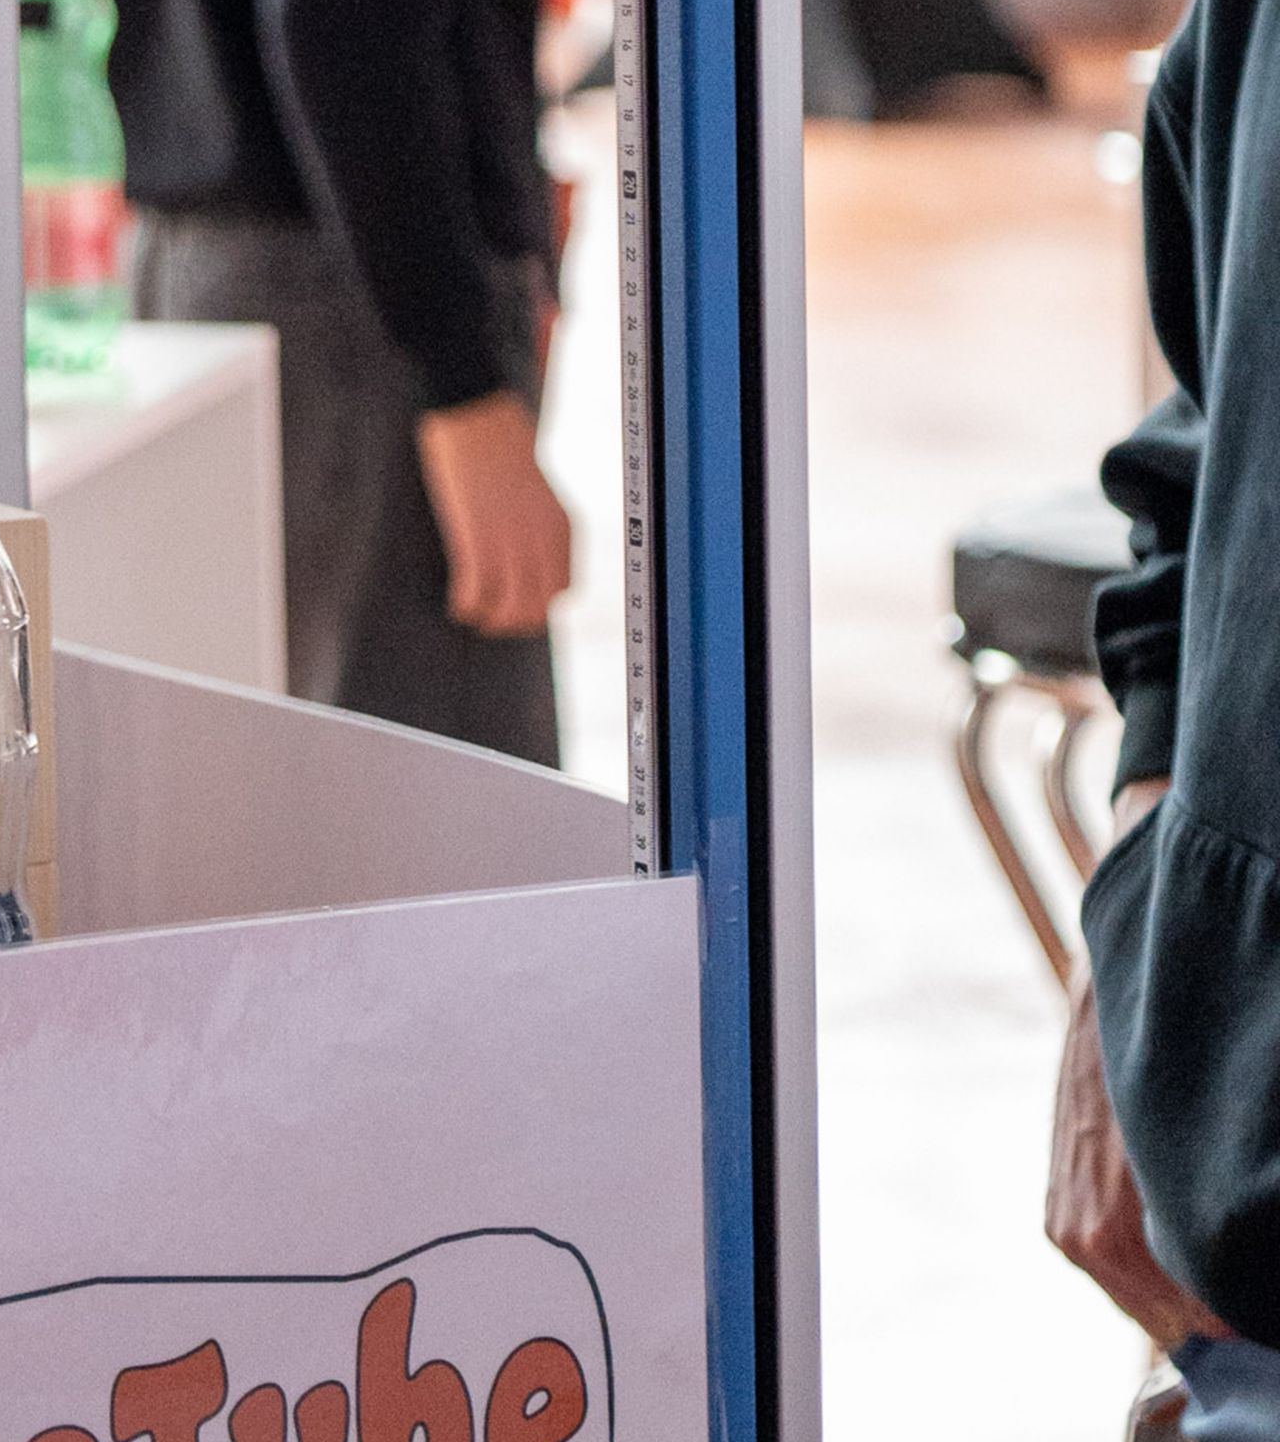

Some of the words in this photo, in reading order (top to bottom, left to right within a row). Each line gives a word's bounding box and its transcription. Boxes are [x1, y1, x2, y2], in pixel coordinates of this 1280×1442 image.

[622, 4, 632, 16] 15
[622, 40, 633, 51] 16
[623, 74, 633, 86] 17
[624, 109, 633, 121] 18
[624, 144, 634, 156] 19
[624, 175, 636, 194] 20
[626, 212, 636, 225] 21
[626, 247, 636, 261] 22
[627, 282, 637, 296] 23
[628, 316, 637, 330] 24
[628, 351, 637, 365] 25
[628, 386, 638, 399] 26
[629, 421, 639, 435] 27
[630, 456, 639, 470] 28
[630, 490, 640, 505] 29
[630, 522, 642, 542] 30
[632, 560, 641, 573] 31
[632, 594, 642, 607] 32
[633, 629, 643, 643] 33
[633, 663, 643, 677] 34
[635, 766, 645, 780] 37
[635, 800, 645, 814] 38
[636, 835, 646, 849] 39
